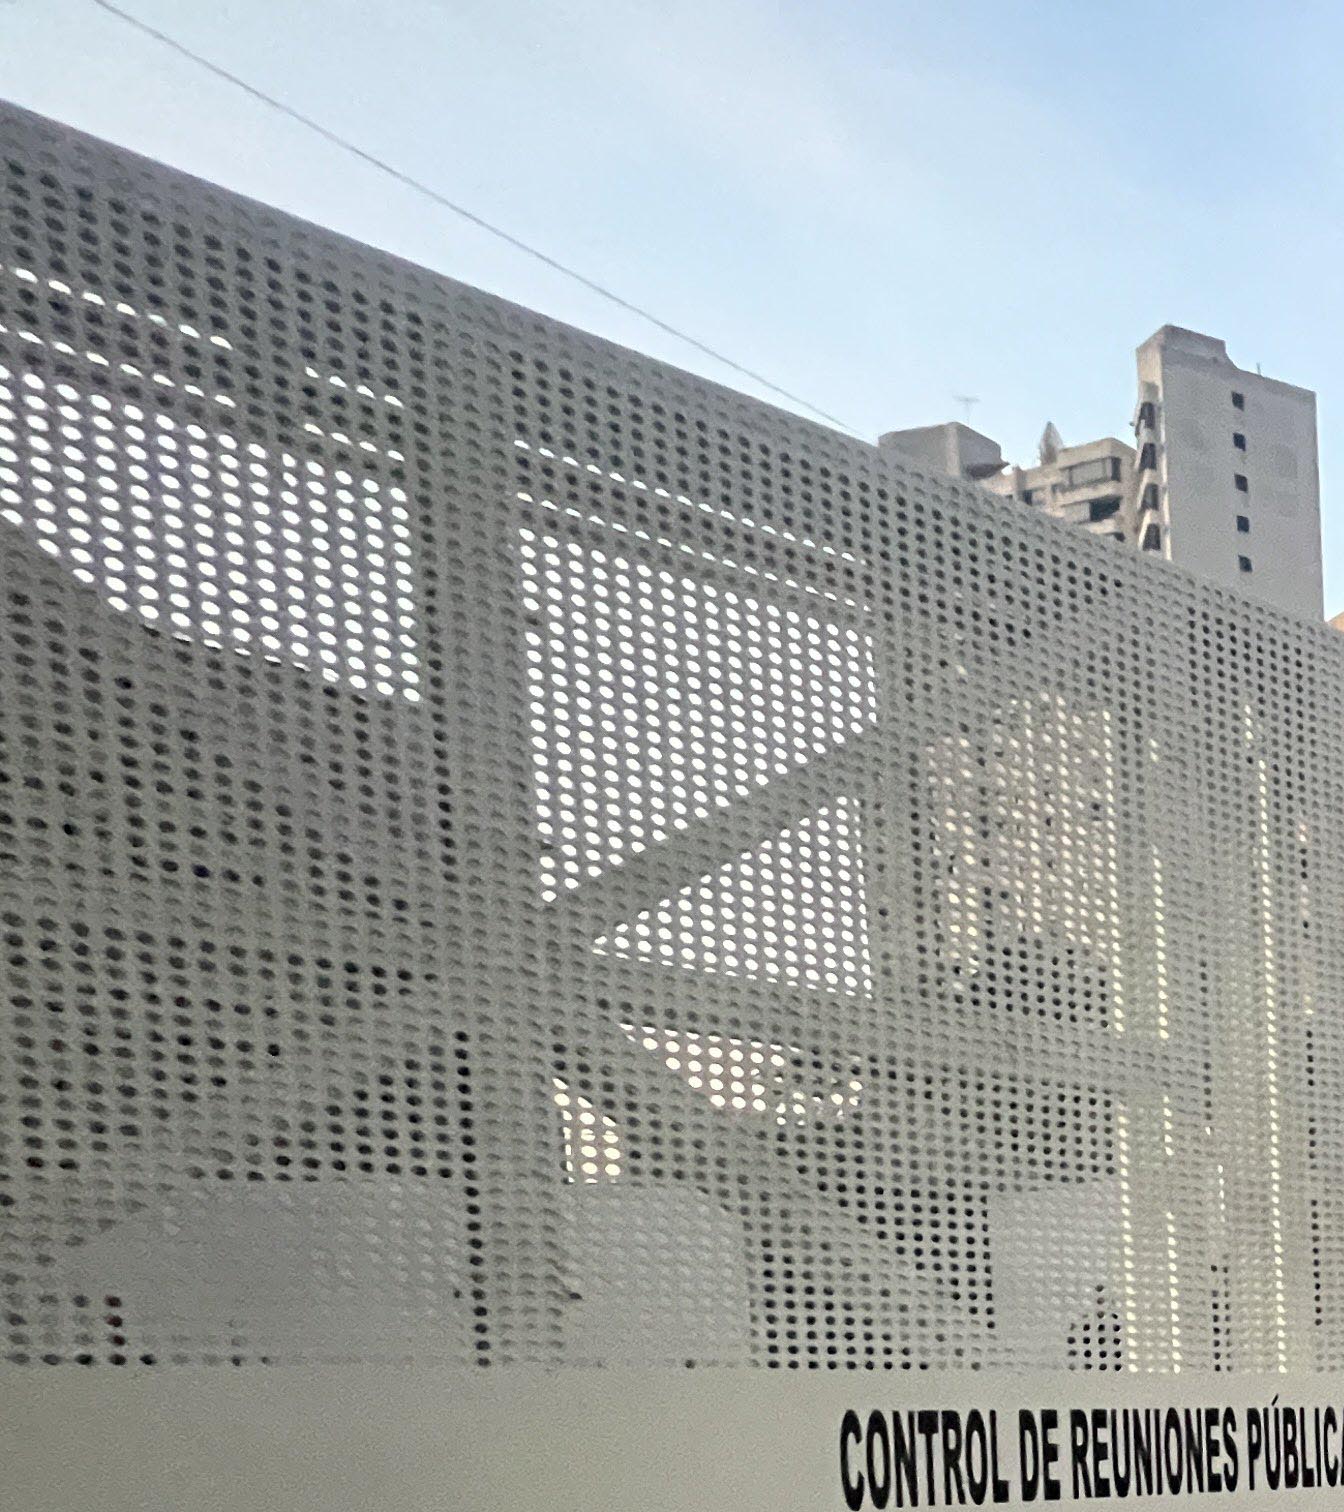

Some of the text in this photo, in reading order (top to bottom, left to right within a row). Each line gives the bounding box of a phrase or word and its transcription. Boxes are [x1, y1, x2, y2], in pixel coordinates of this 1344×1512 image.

[839, 1408, 1010, 1512] CONTROL
[1018, 1409, 1061, 1502] DE
[1069, 1406, 1239, 1500] REUNIONES
